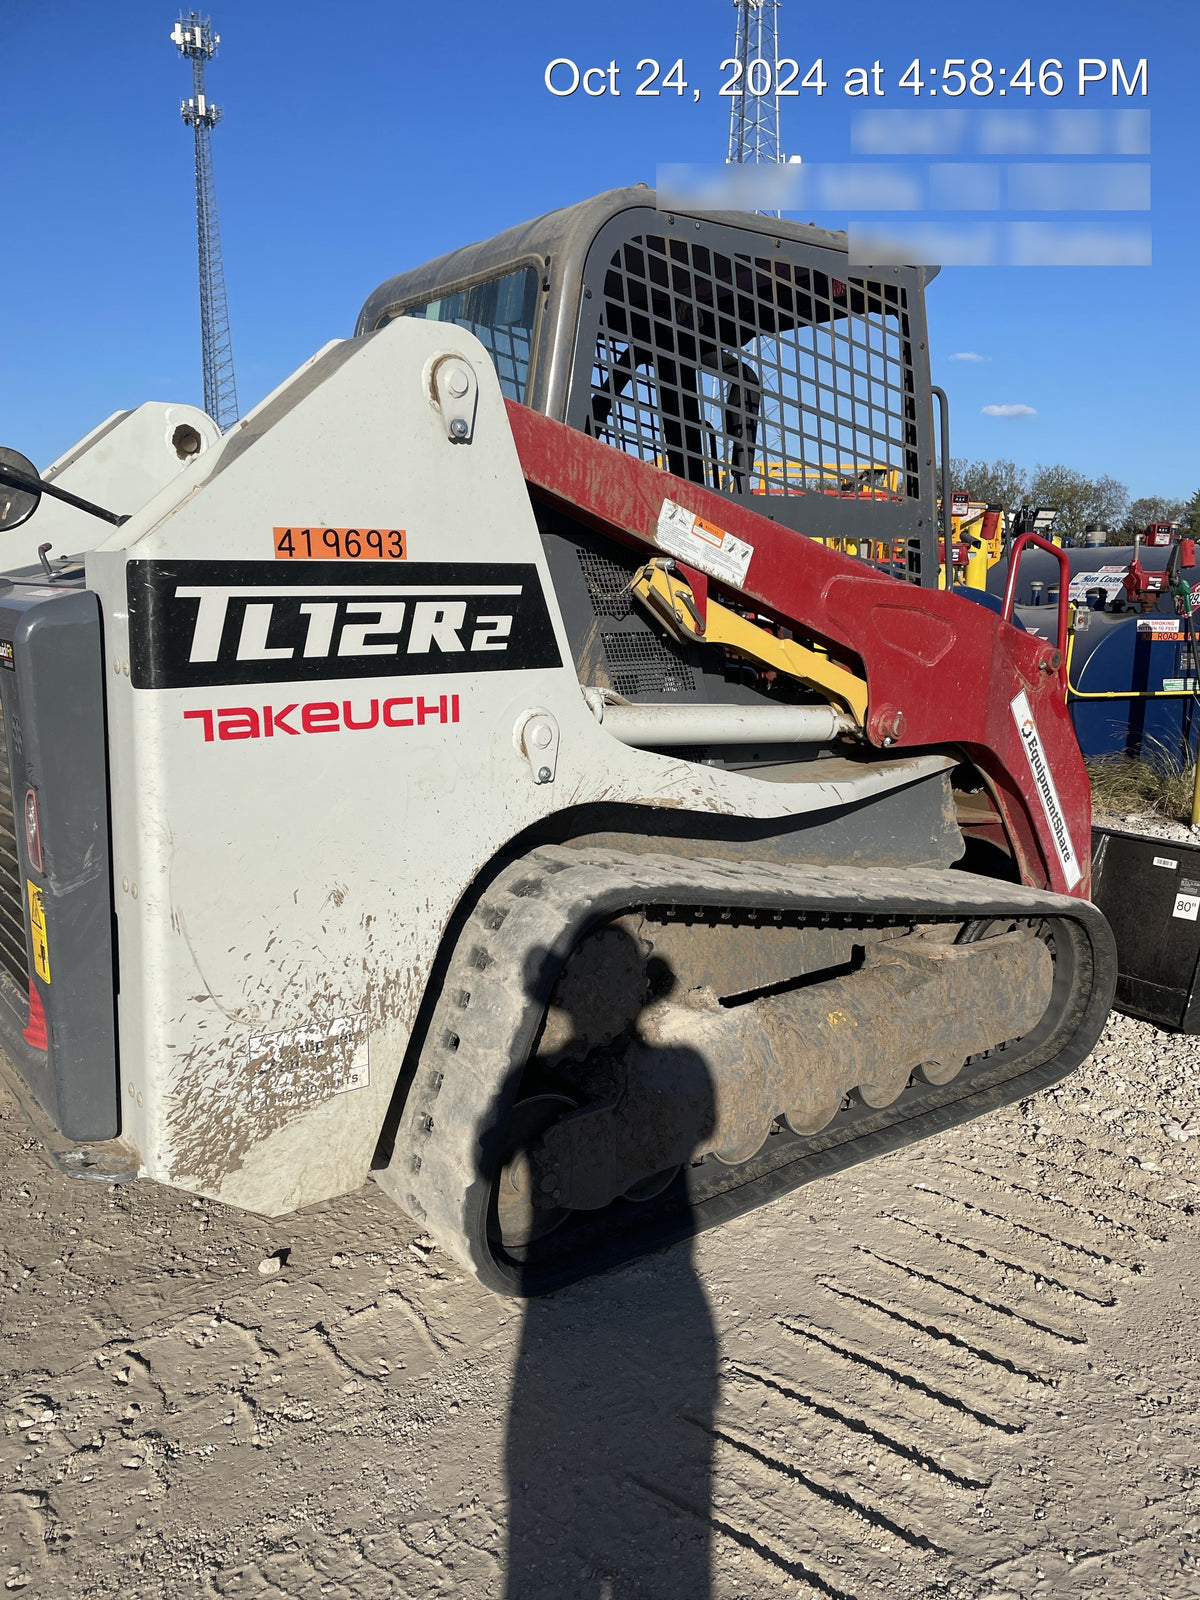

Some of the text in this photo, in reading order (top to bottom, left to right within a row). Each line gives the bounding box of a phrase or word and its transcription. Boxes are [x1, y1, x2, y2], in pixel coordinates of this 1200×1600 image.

[277, 528, 404, 559] 419693
[174, 585, 523, 664] TL12R2
[1157, 632, 1179, 640] ROAD
[1027, 735, 1071, 863] EquipmentShare
[1176, 900, 1197, 913] 80"
